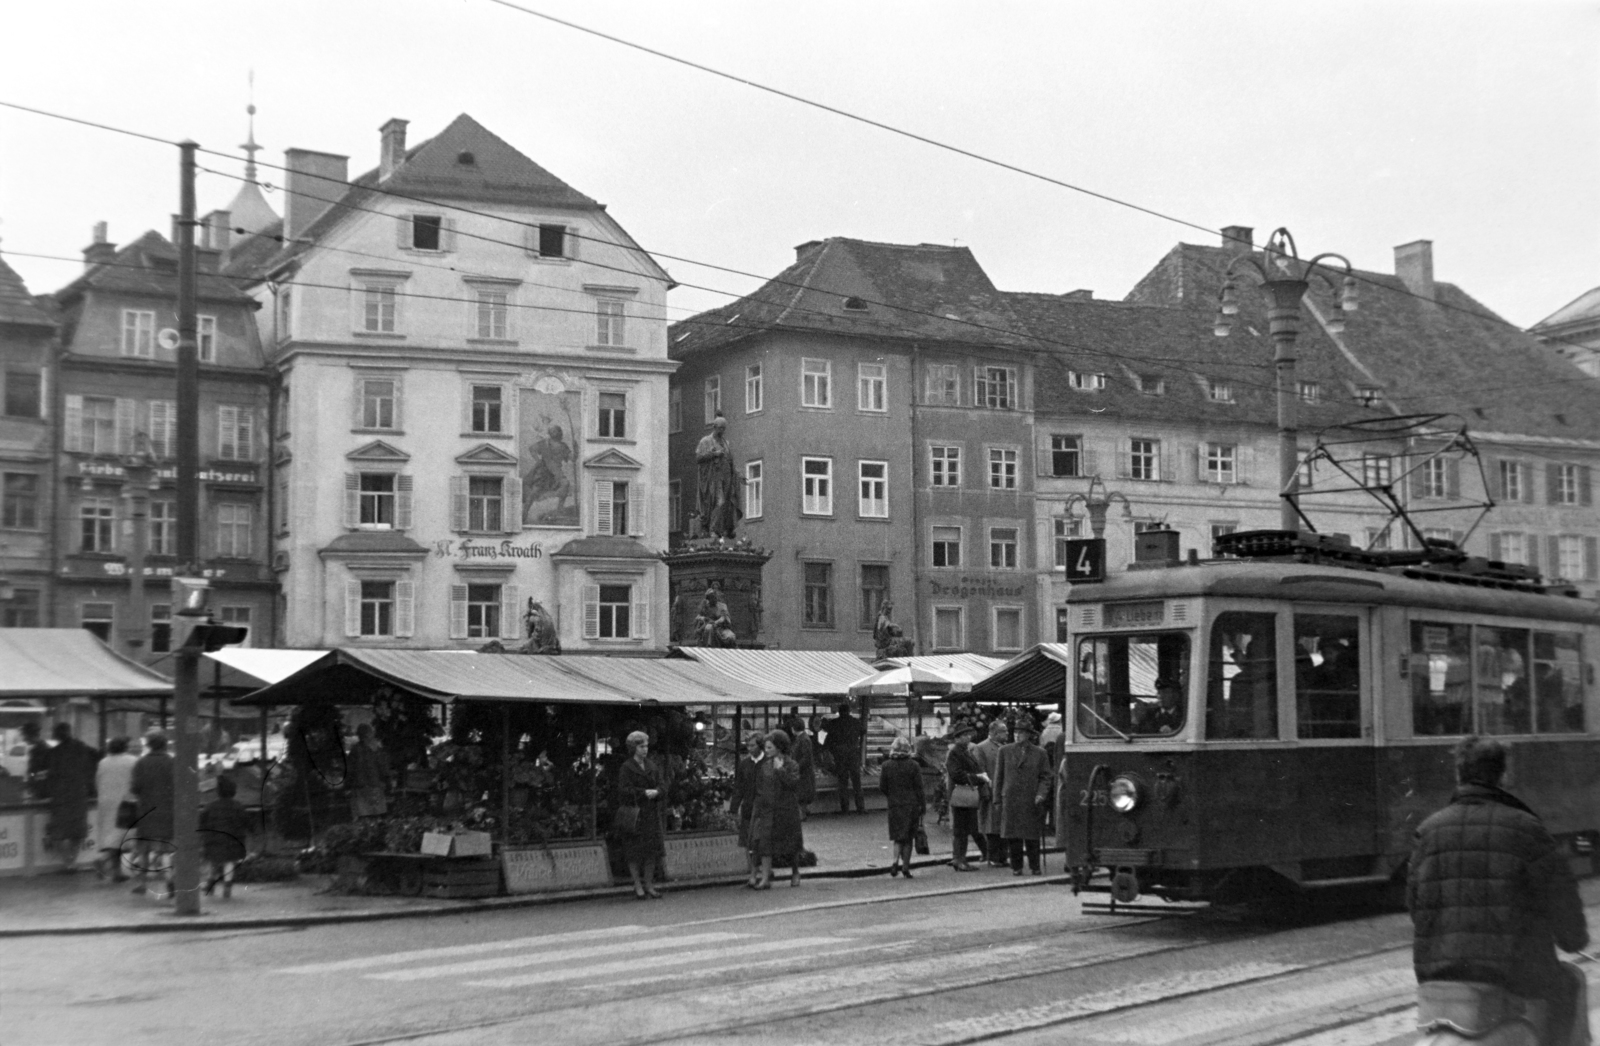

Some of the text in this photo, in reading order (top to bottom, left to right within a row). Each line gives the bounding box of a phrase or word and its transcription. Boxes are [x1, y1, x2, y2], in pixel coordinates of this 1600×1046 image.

[196, 468, 255, 483] utzerei
[458, 538, 497, 561] Franz
[498, 540, 544, 560] Kroath
[1075, 545, 1092, 576] 4
[1079, 789, 1109, 806] 225
